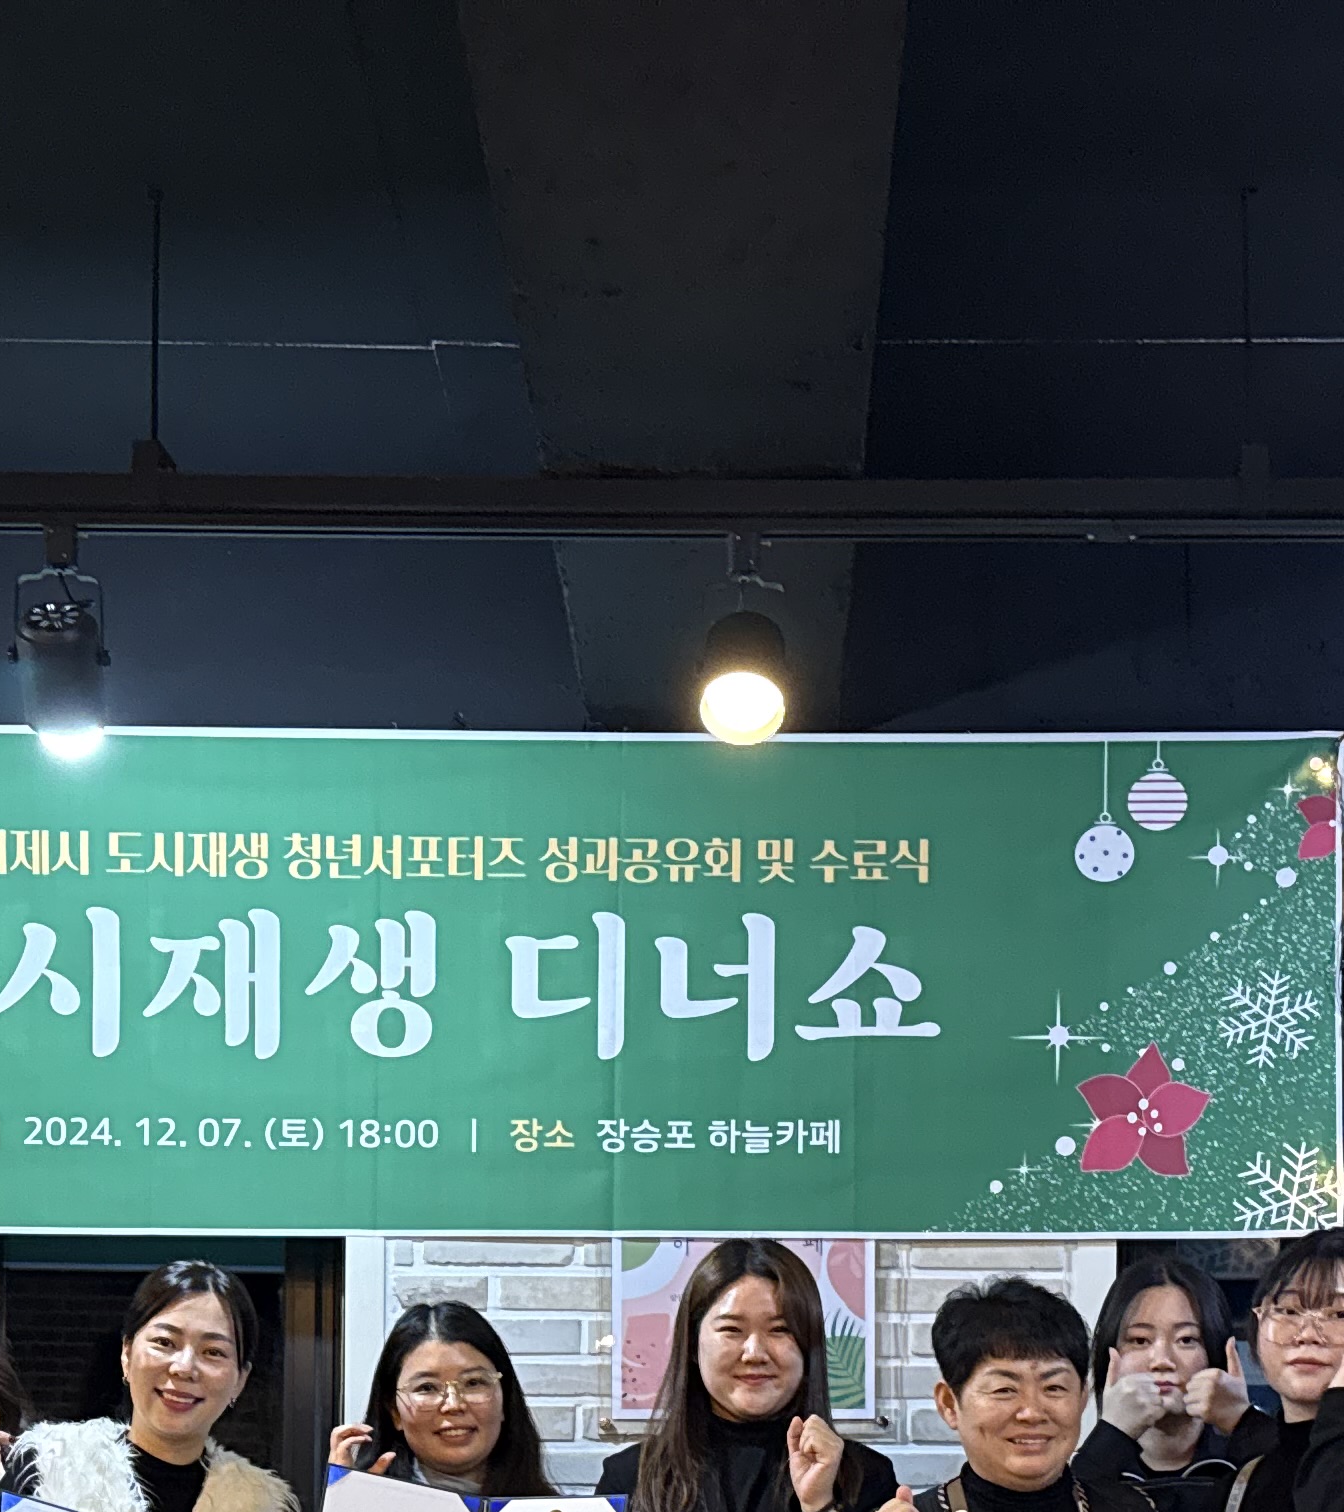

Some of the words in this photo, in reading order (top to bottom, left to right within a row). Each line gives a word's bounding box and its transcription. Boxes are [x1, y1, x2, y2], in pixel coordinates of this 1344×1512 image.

[105, 830, 270, 880] 도시재생
[281, 831, 527, 881] 청년서포터즈
[538, 835, 742, 884] 성과공유회
[757, 837, 796, 885] 및
[808, 837, 930, 884] 수료식
[504, 910, 942, 1062] 디너쇼
[22, 1115, 123, 1147] 2024.
[134, 1116, 188, 1148] 12.
[197, 1117, 253, 1149] 07.
[263, 1117, 325, 1152] (토)
[338, 1118, 440, 1149] 18:00
[509, 1117, 576, 1153] 장소
[595, 1117, 697, 1154] 장승포
[707, 1118, 842, 1155] 하늘카페
